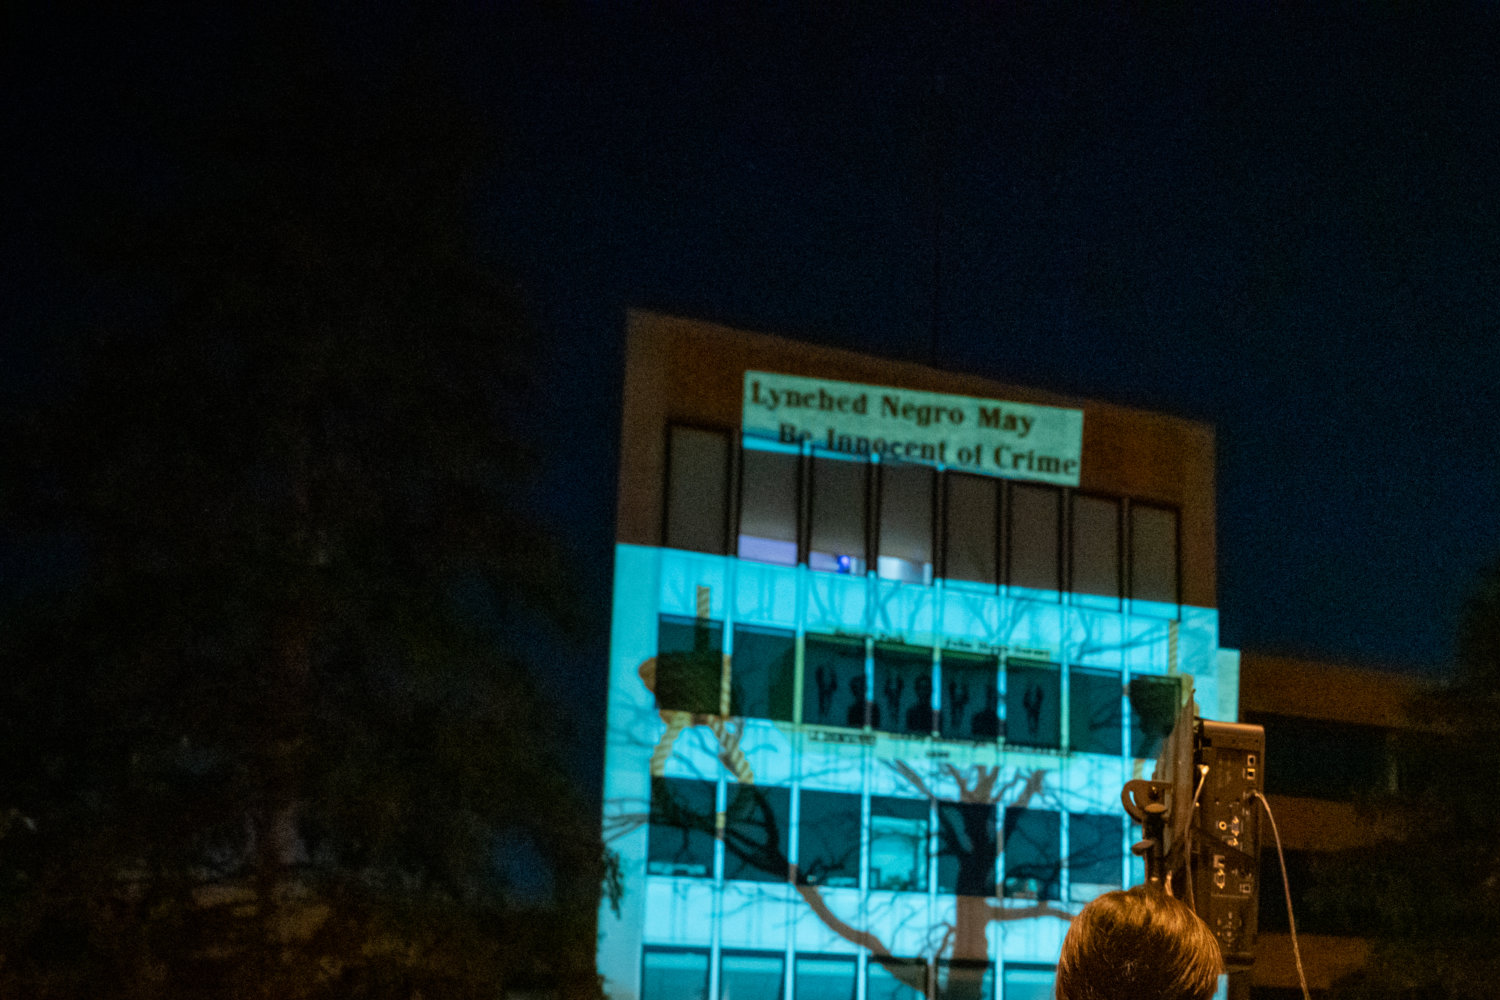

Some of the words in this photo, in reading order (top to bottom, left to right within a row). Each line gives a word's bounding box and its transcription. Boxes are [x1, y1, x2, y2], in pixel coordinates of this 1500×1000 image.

[751, 379, 868, 415] Lynched
[881, 395, 965, 427] Negro
[978, 406, 1036, 439] May
[779, 423, 812, 446] Be
[826, 427, 948, 463] Innocent
[957, 443, 984, 467] of
[993, 448, 1079, 477] Crime
